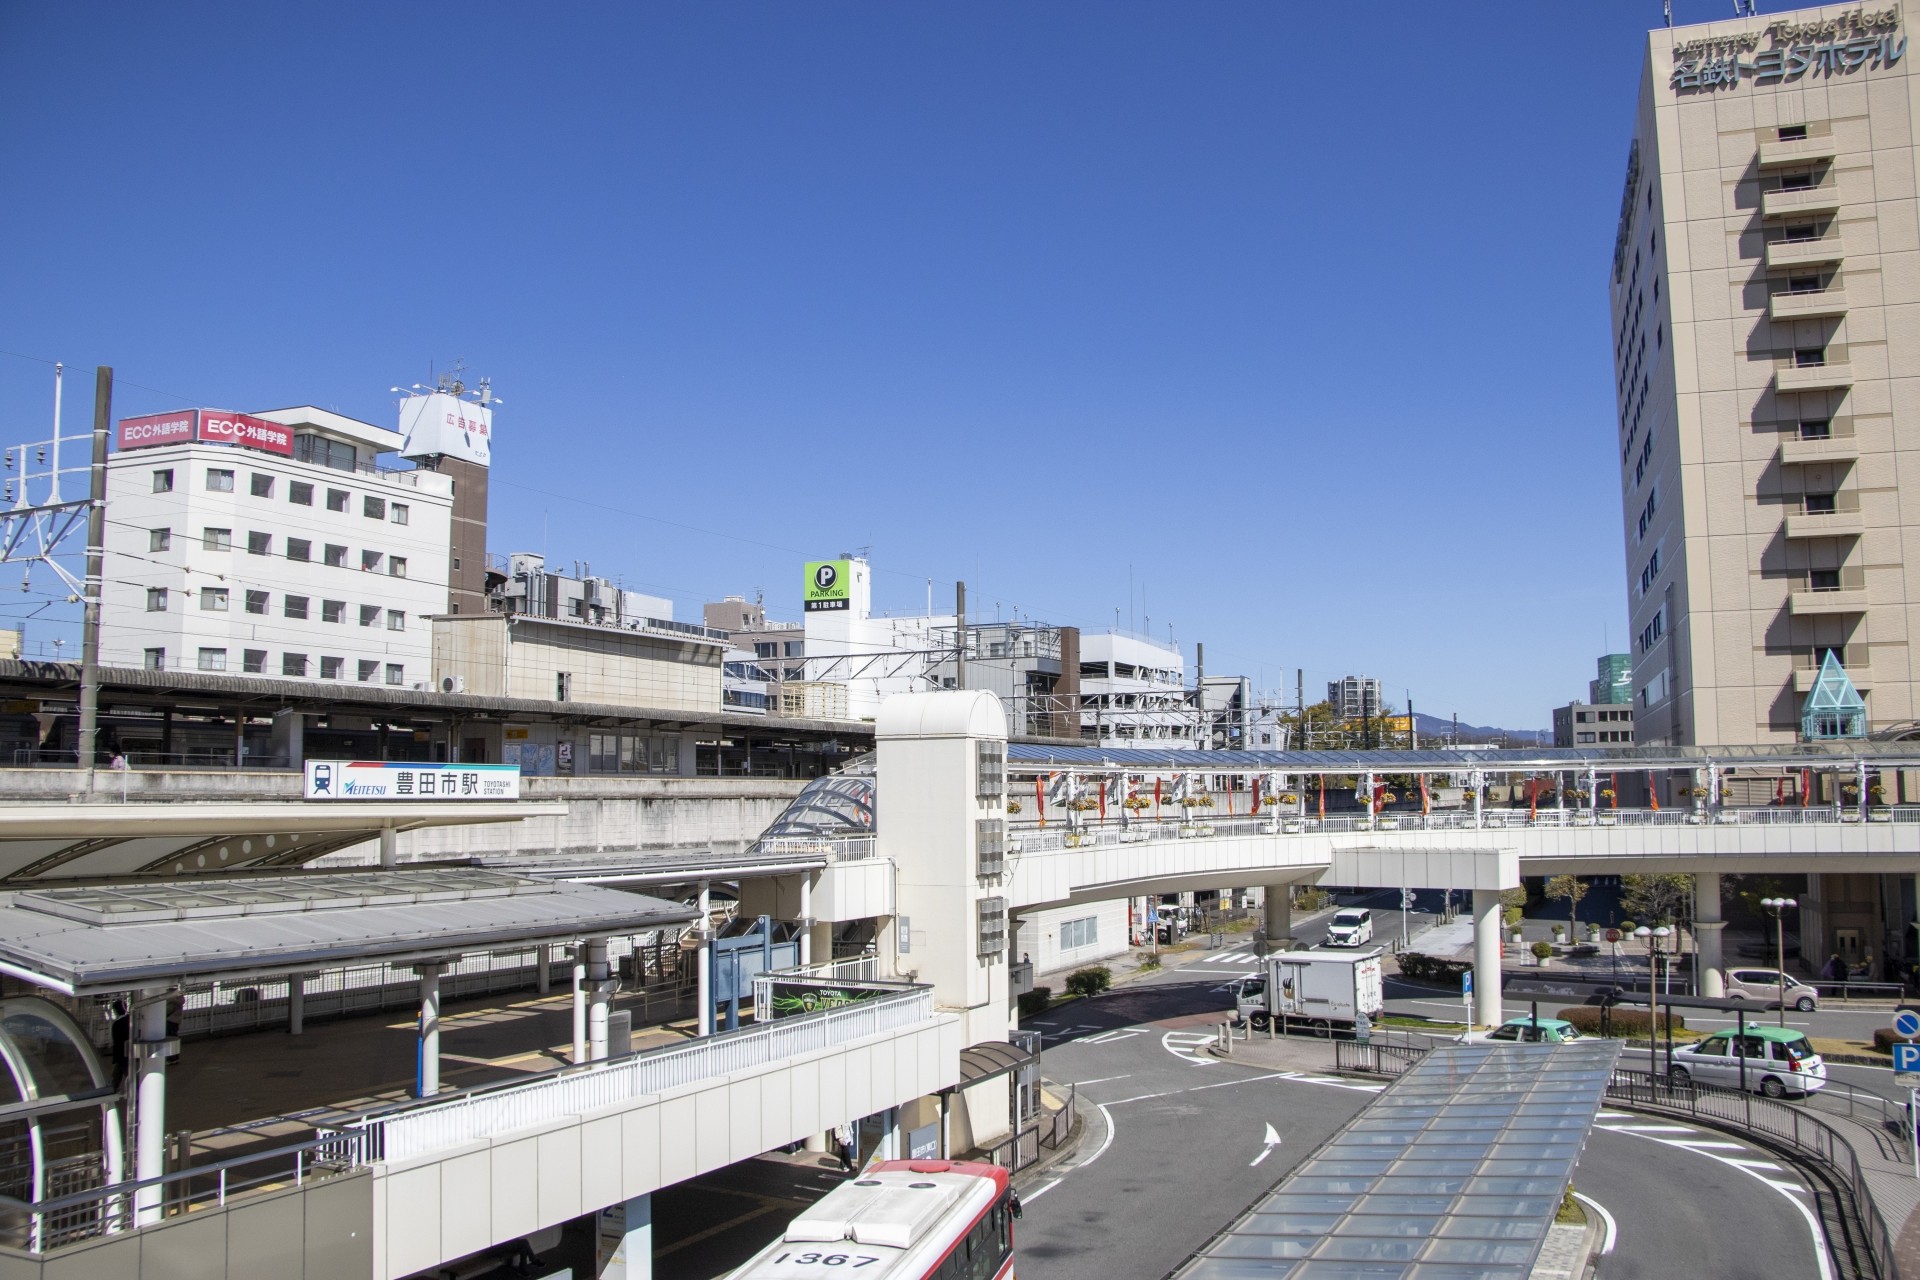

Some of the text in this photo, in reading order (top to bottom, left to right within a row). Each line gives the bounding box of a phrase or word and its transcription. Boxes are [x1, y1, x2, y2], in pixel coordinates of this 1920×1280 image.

[1770, 17, 1838, 42] Toyota
[1843, 3, 1902, 32] Hotel
[1675, 36, 1908, 88] 名鉄トヨタホテル
[124, 420, 189, 441] ECC外語学院
[207, 419, 288, 446] ECC外語学院
[446, 413, 488, 436] 広告募集
[820, 567, 833, 585] P
[810, 590, 844, 598] PARKING
[811, 600, 843, 609] 第1駐車場
[396, 771, 478, 795] 豊田市駅
[484, 780, 511, 788] TOYOTASHI
[1465, 974, 1471, 991] P
[820, 989, 842, 997] TOYOTA
[1902, 1047, 1919, 1069] P
[774, 1252, 880, 1268] 1367
